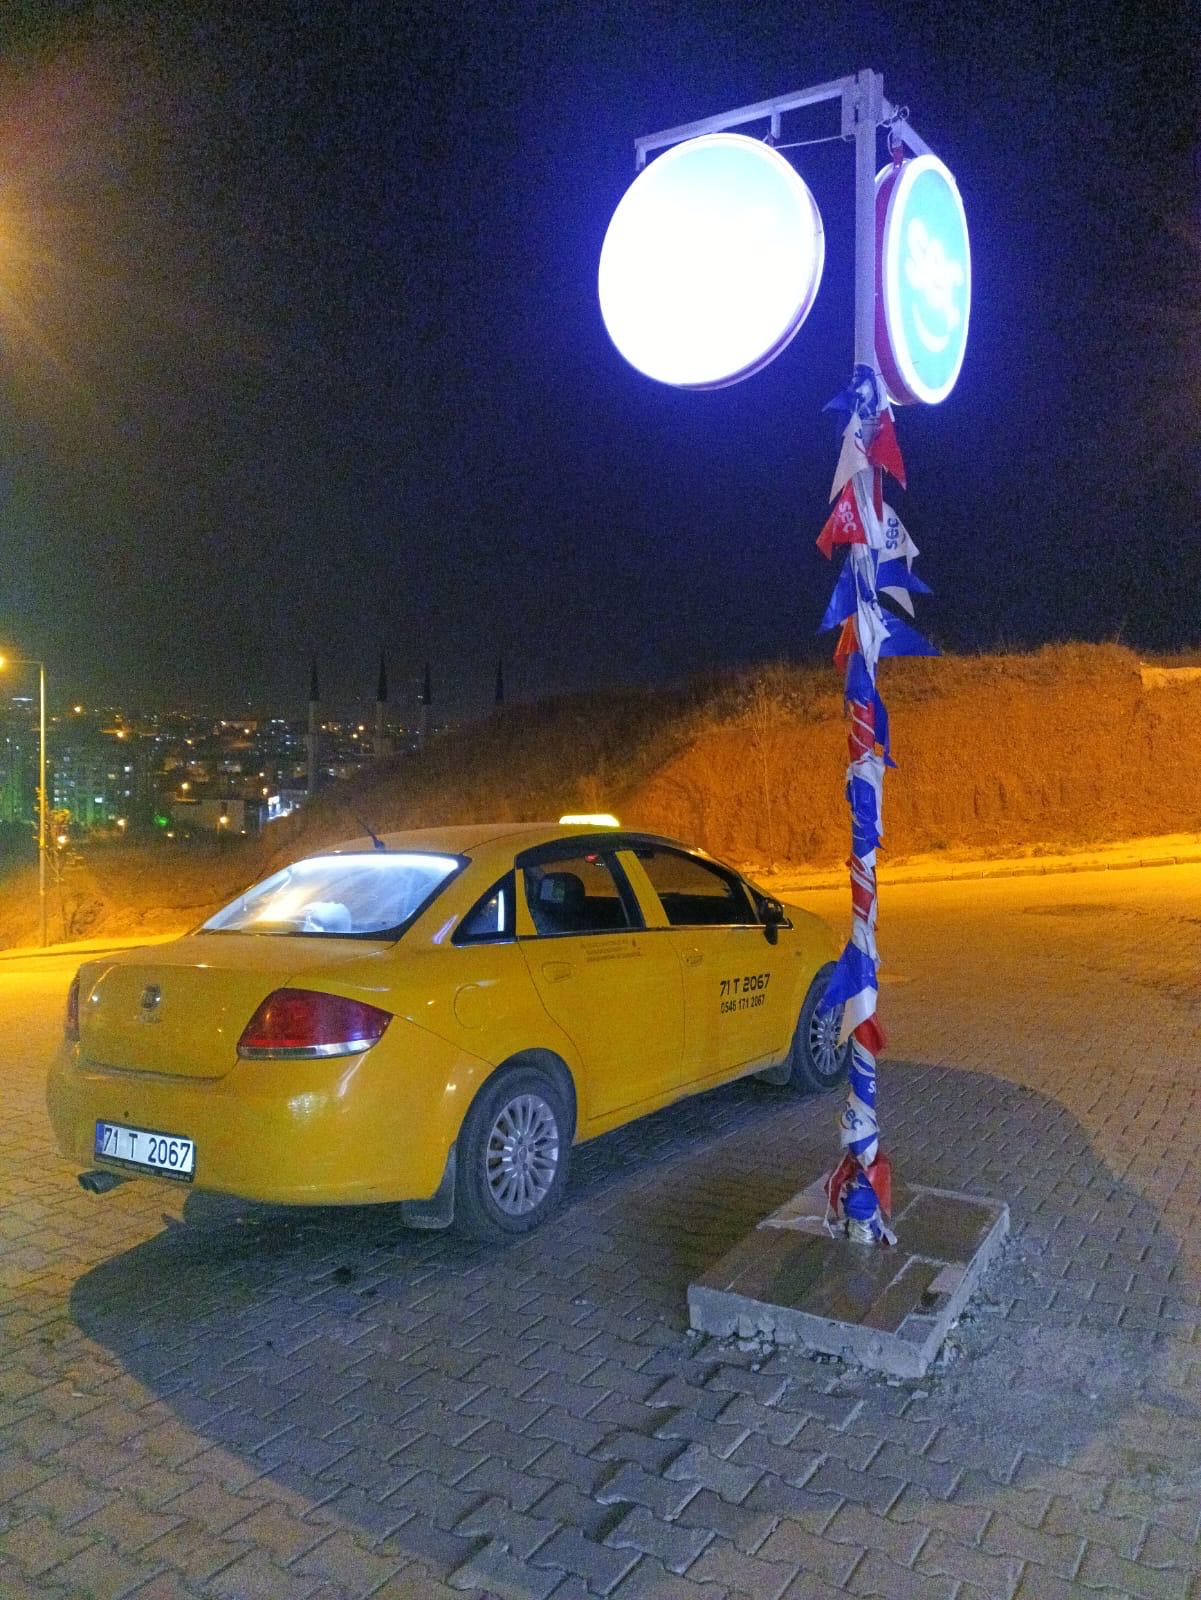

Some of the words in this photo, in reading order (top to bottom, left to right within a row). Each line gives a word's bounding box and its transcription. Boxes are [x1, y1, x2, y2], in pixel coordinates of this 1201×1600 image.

[720, 980, 730, 996] 71
[734, 978, 740, 994] T
[743, 973, 770, 992] 2067
[104, 1128, 118, 1154] 71
[129, 1133, 138, 1158] T
[148, 1137, 190, 1168] 2067
